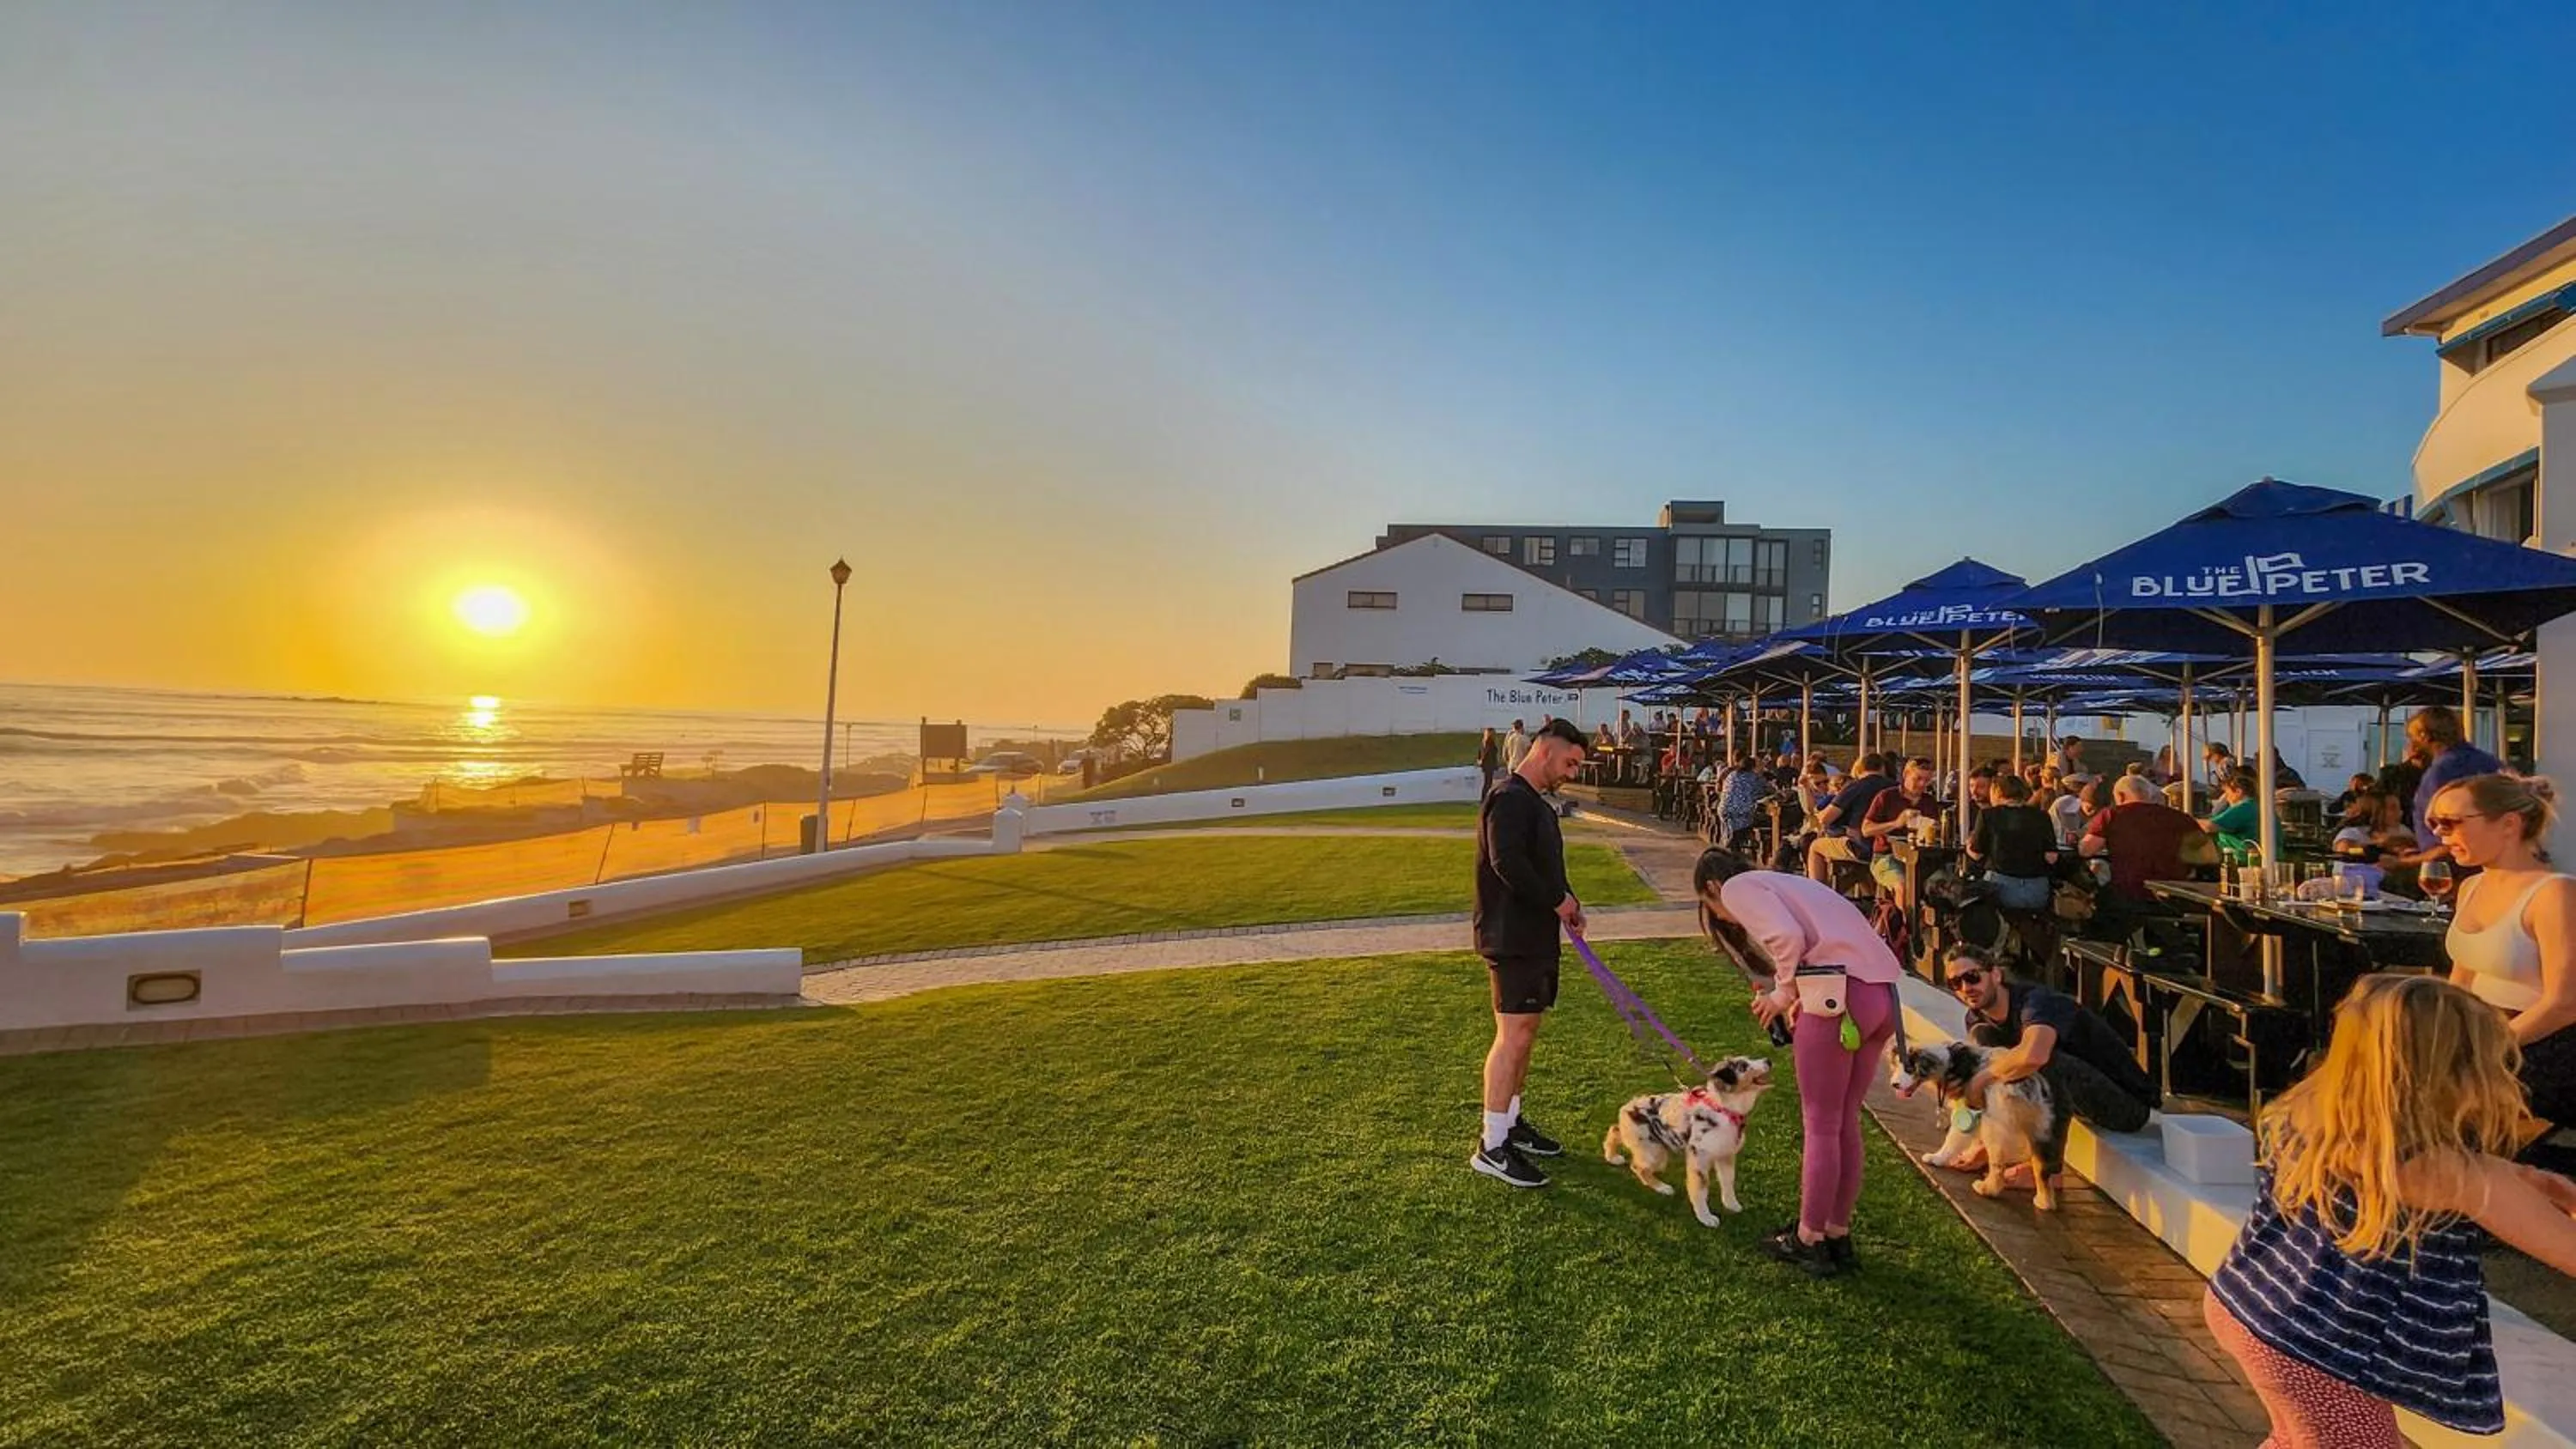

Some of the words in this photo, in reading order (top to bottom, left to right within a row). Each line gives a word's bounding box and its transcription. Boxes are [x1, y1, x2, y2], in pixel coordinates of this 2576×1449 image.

[2131, 575, 2246, 597] BLUE
[2266, 561, 2432, 595] PETER
[1864, 614, 1938, 627] BLUE
[1486, 688, 1505, 703] The
[1510, 689, 1532, 704] Blue
[1535, 689, 1562, 704] Peter
